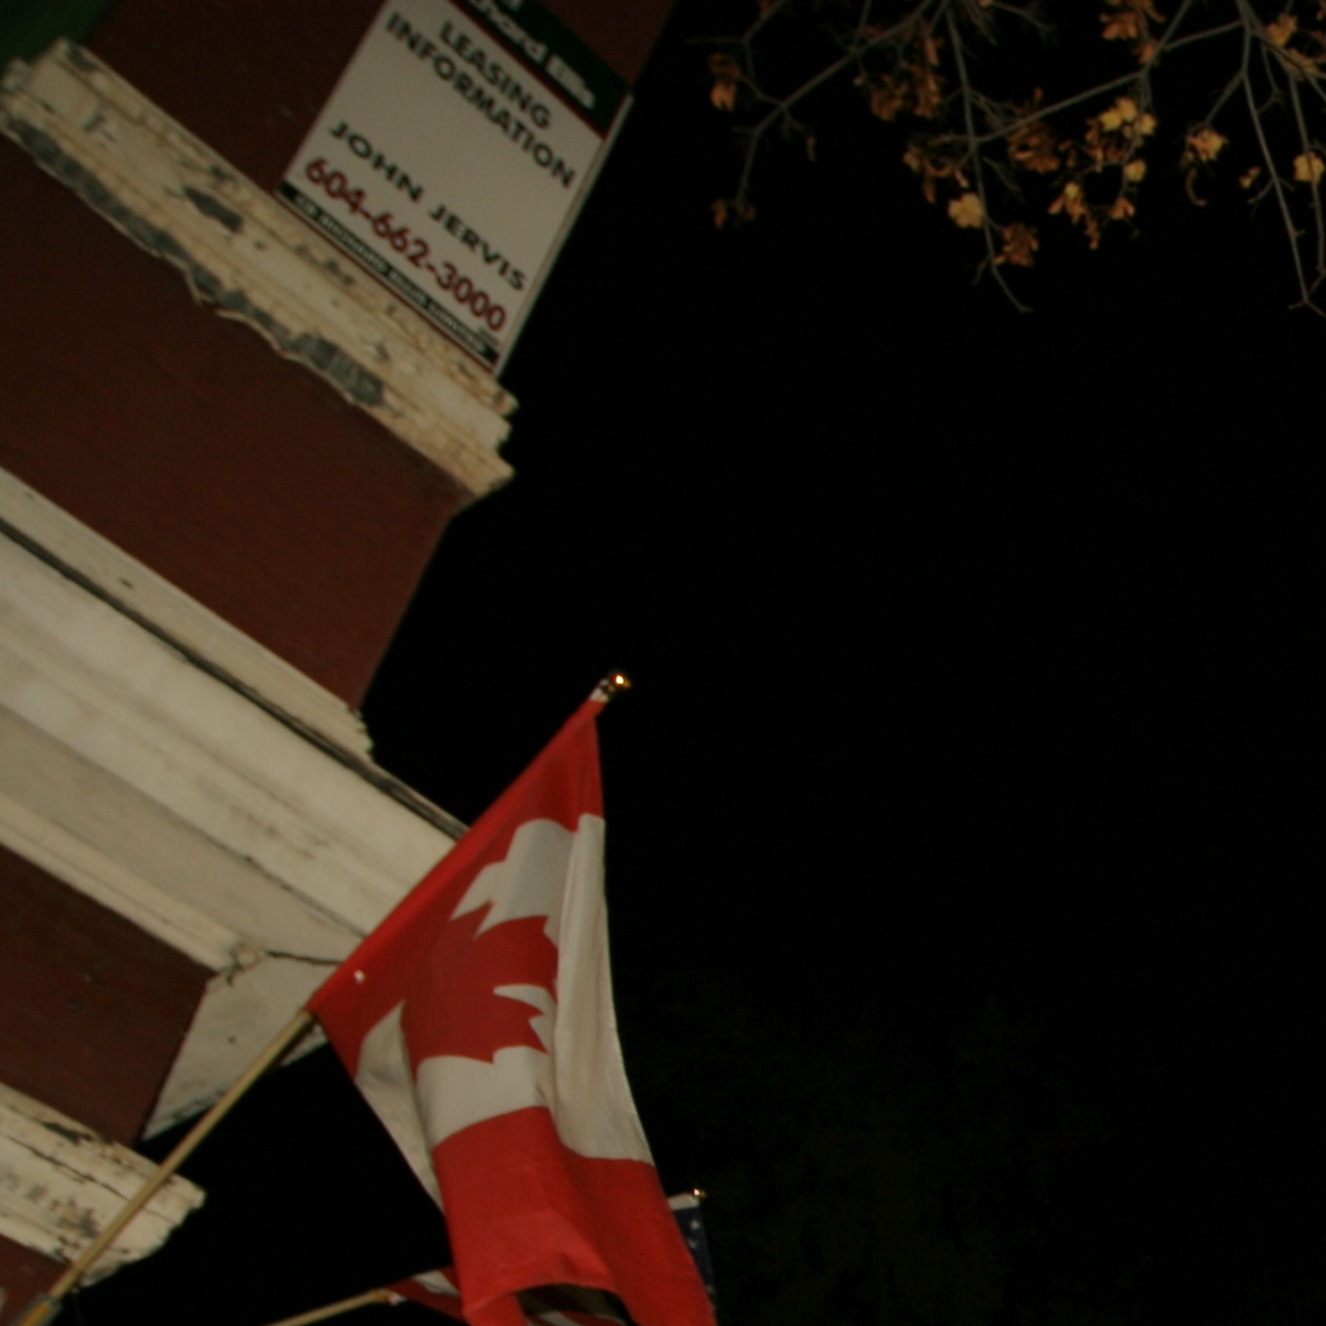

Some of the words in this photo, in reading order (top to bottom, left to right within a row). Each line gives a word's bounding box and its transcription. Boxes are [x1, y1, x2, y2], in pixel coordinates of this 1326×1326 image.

[386, 11, 576, 189] INFORMATION
[439, 20, 552, 129] LEASING
[305, 157, 506, 333] 604-662-3000
[329, 120, 425, 204] JOHN
[428, 204, 526, 292] JERVIS
